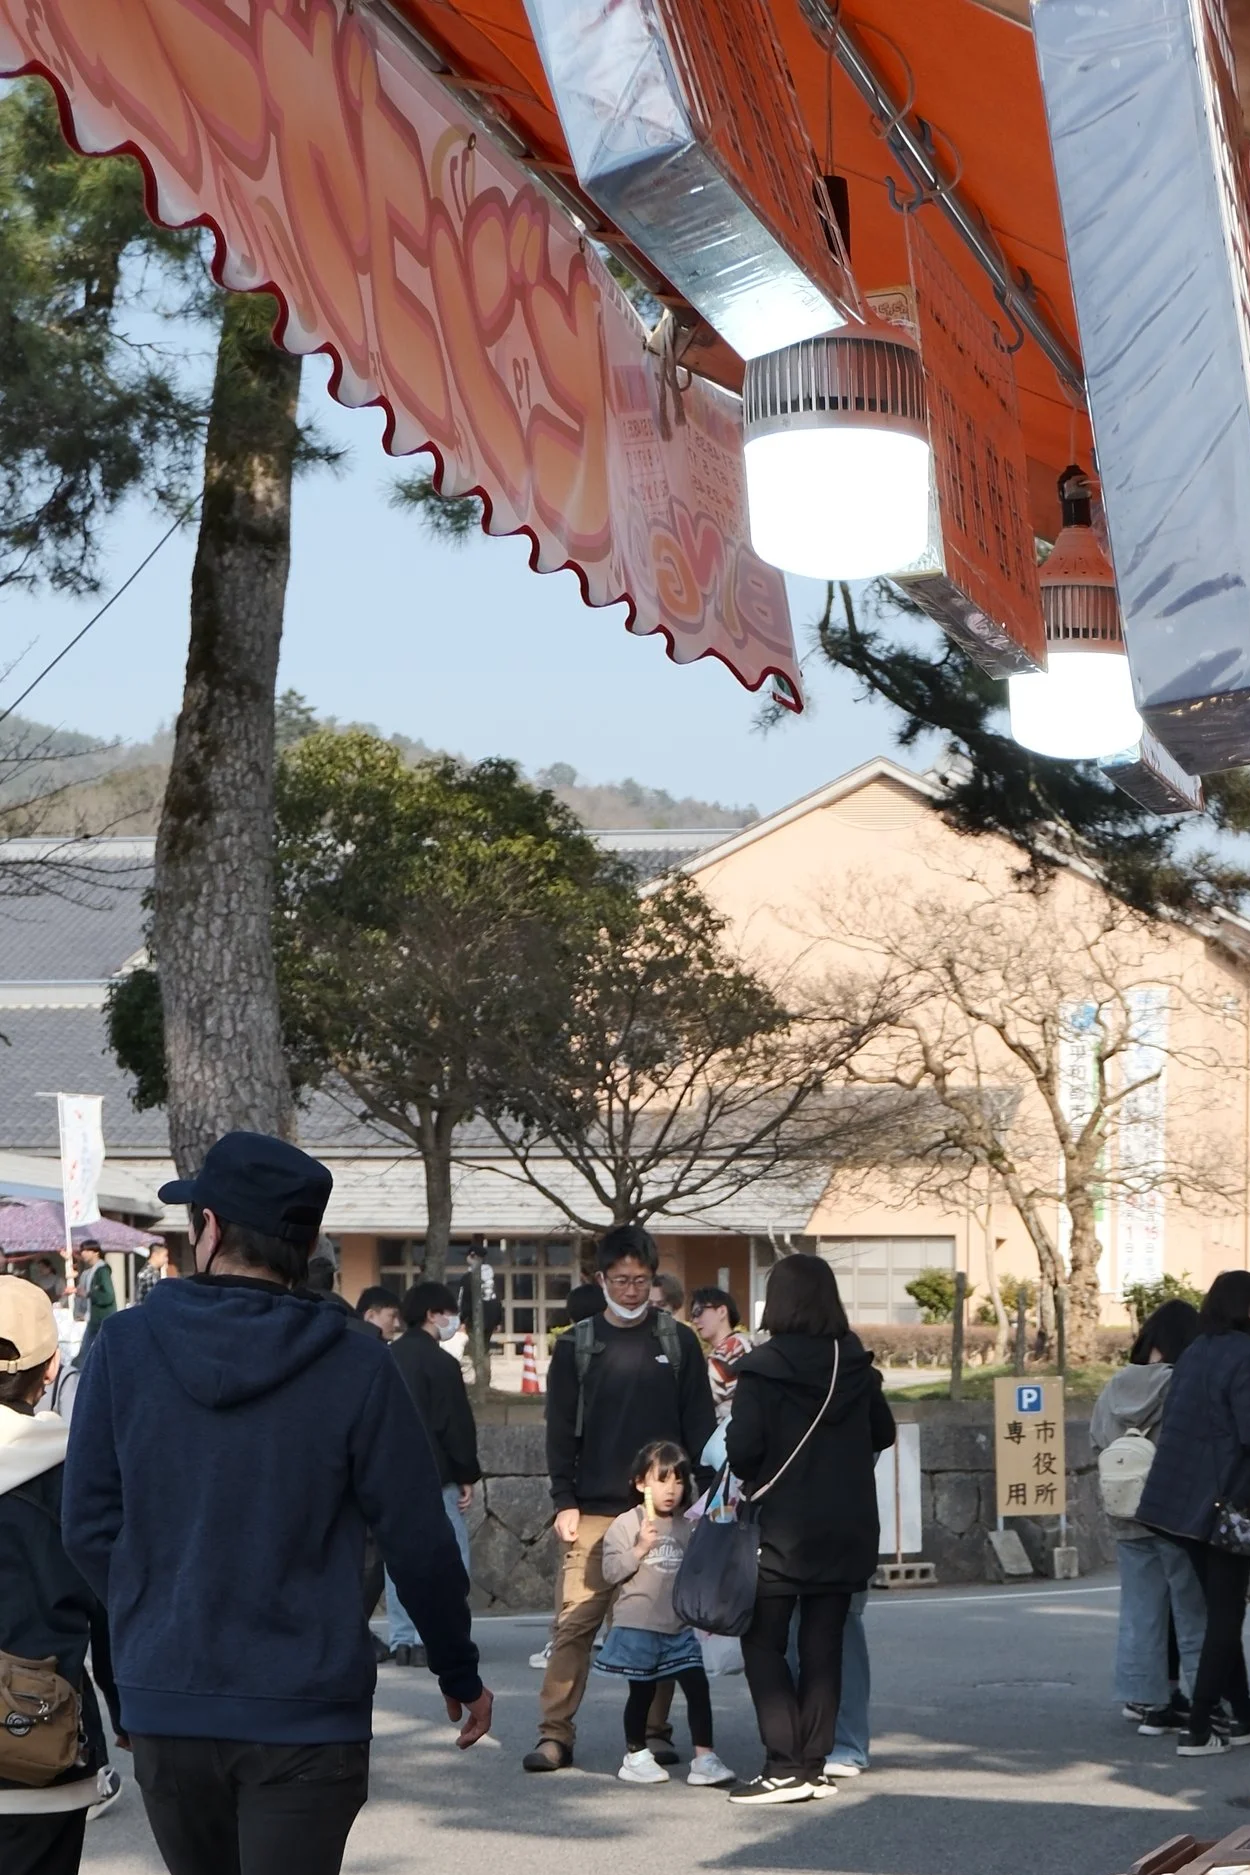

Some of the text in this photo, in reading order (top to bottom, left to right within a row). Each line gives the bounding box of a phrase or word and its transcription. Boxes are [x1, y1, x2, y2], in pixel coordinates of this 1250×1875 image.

[1021, 1389, 1038, 1410] P
[1003, 1420, 1028, 1506] 専用
[1032, 1420, 1058, 1506] 市役所
